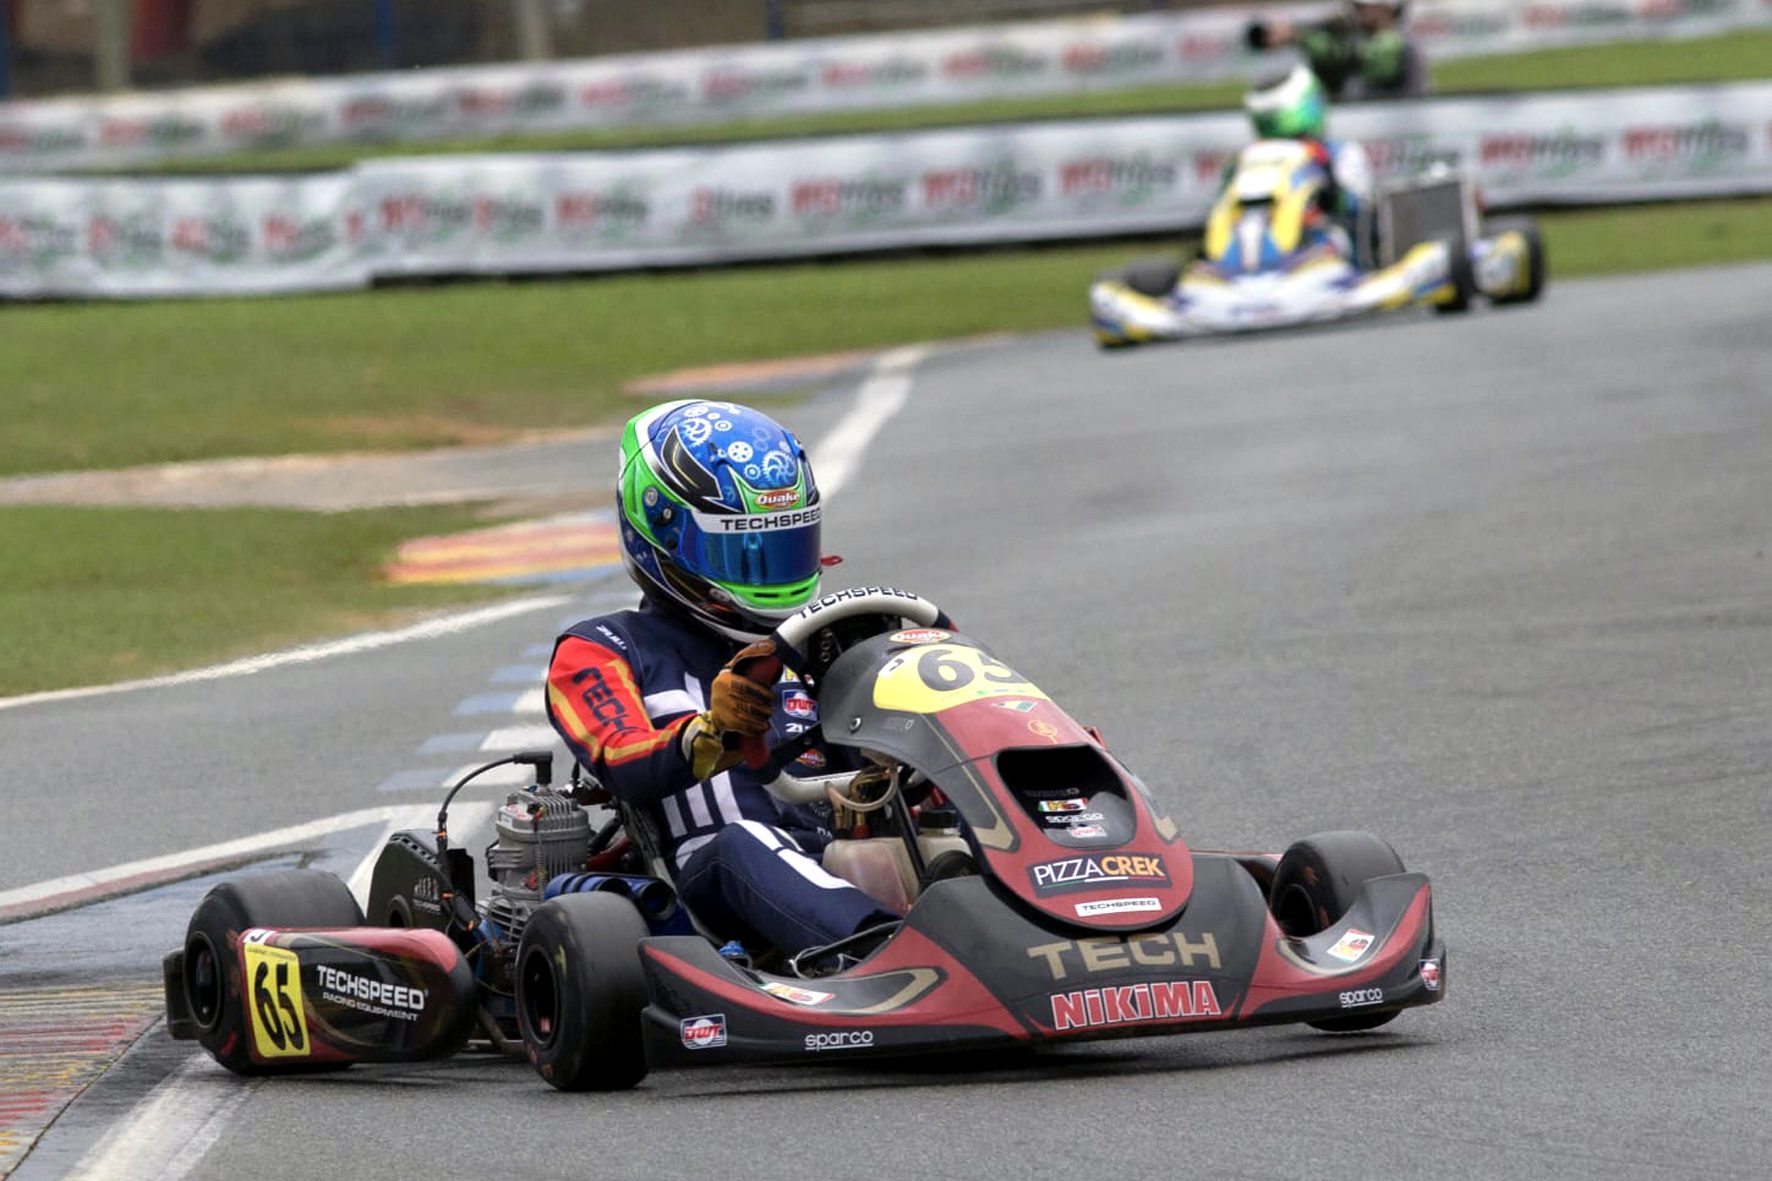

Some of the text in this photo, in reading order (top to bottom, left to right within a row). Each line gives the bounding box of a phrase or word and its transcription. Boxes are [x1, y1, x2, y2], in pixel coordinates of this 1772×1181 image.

[755, 490, 801, 507] Quake
[917, 649, 1031, 692] 65
[1082, 900, 1157, 911] TECHSPEED
[1027, 932, 1223, 980] TECH
[317, 965, 425, 1010] TECHSPEED
[1339, 988, 1384, 1008] sparco
[255, 961, 304, 1051] 65
[323, 992, 419, 1022] RACING EQUIPMENT
[804, 1029, 874, 1051] sparco
